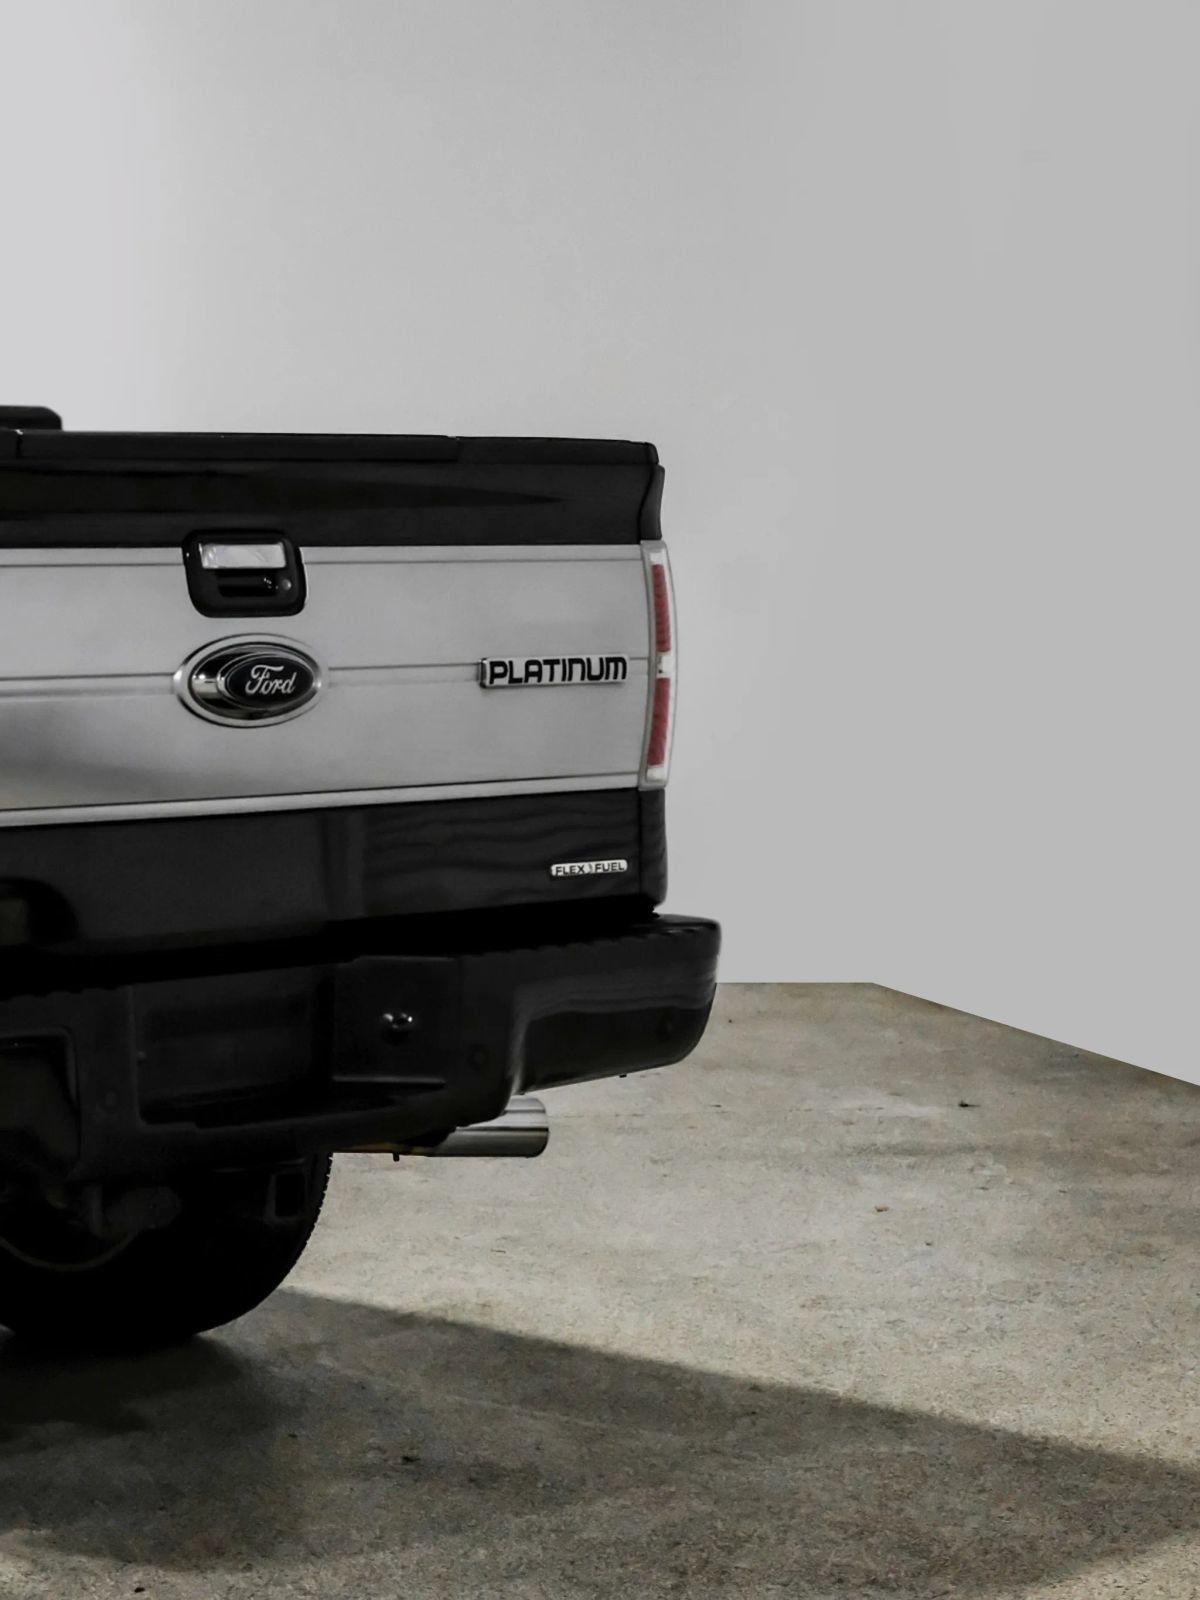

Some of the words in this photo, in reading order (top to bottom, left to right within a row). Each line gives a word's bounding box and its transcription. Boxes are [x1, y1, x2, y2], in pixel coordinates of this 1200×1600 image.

[245, 664, 298, 695] Ford
[489, 656, 628, 685] PLATINUM
[555, 864, 585, 875] FLEX
[595, 862, 625, 872] FUEL
